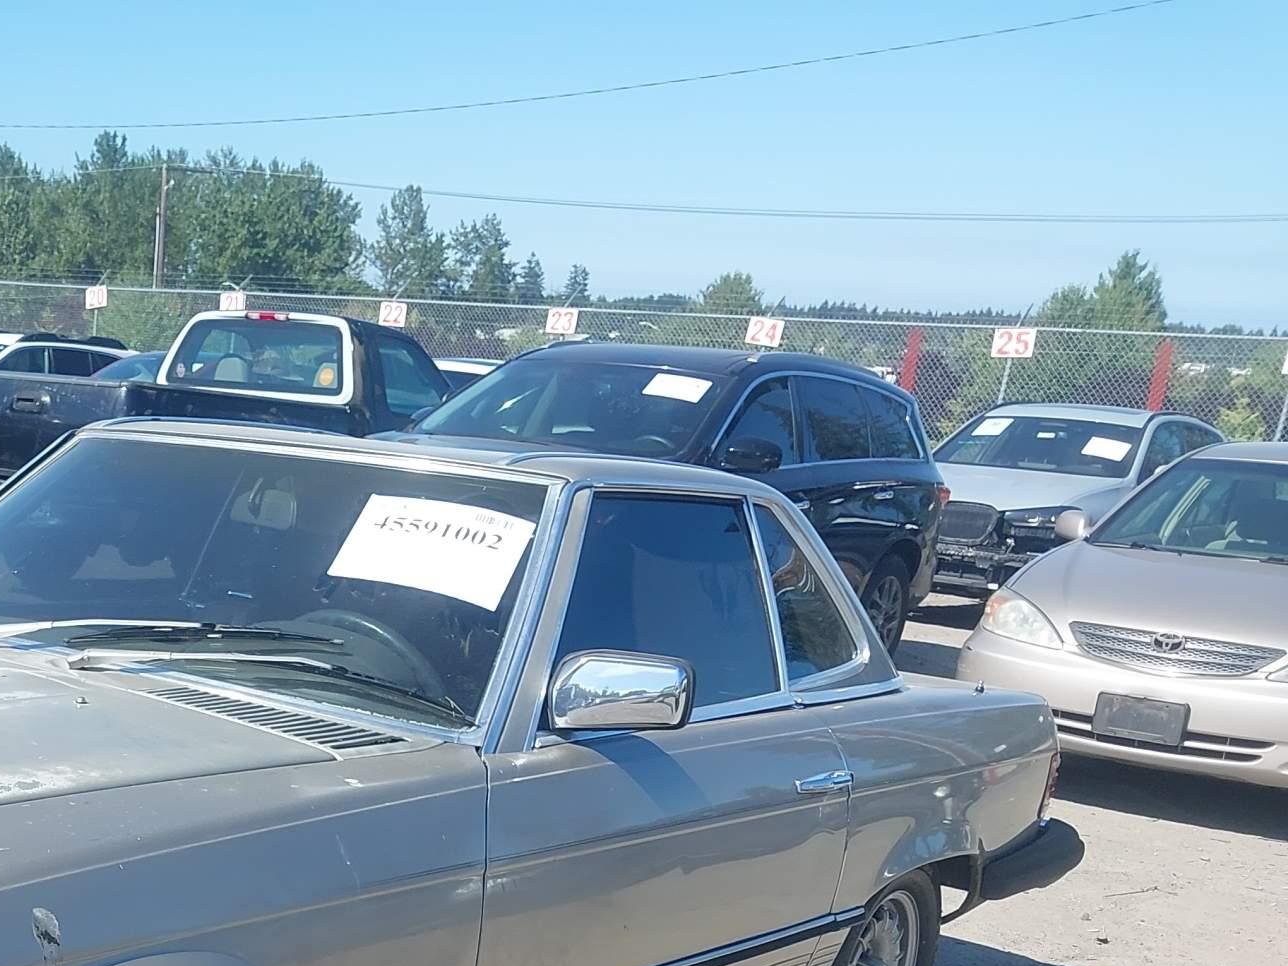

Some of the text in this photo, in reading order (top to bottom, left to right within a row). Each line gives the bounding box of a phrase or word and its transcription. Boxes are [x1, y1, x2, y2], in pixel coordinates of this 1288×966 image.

[88, 288, 104, 307] 20
[225, 294, 239, 311] 21
[382, 304, 404, 325] 22
[550, 310, 575, 332] 23
[749, 318, 779, 344] 24
[996, 330, 1031, 356] 25
[373, 515, 504, 551] 45591002
